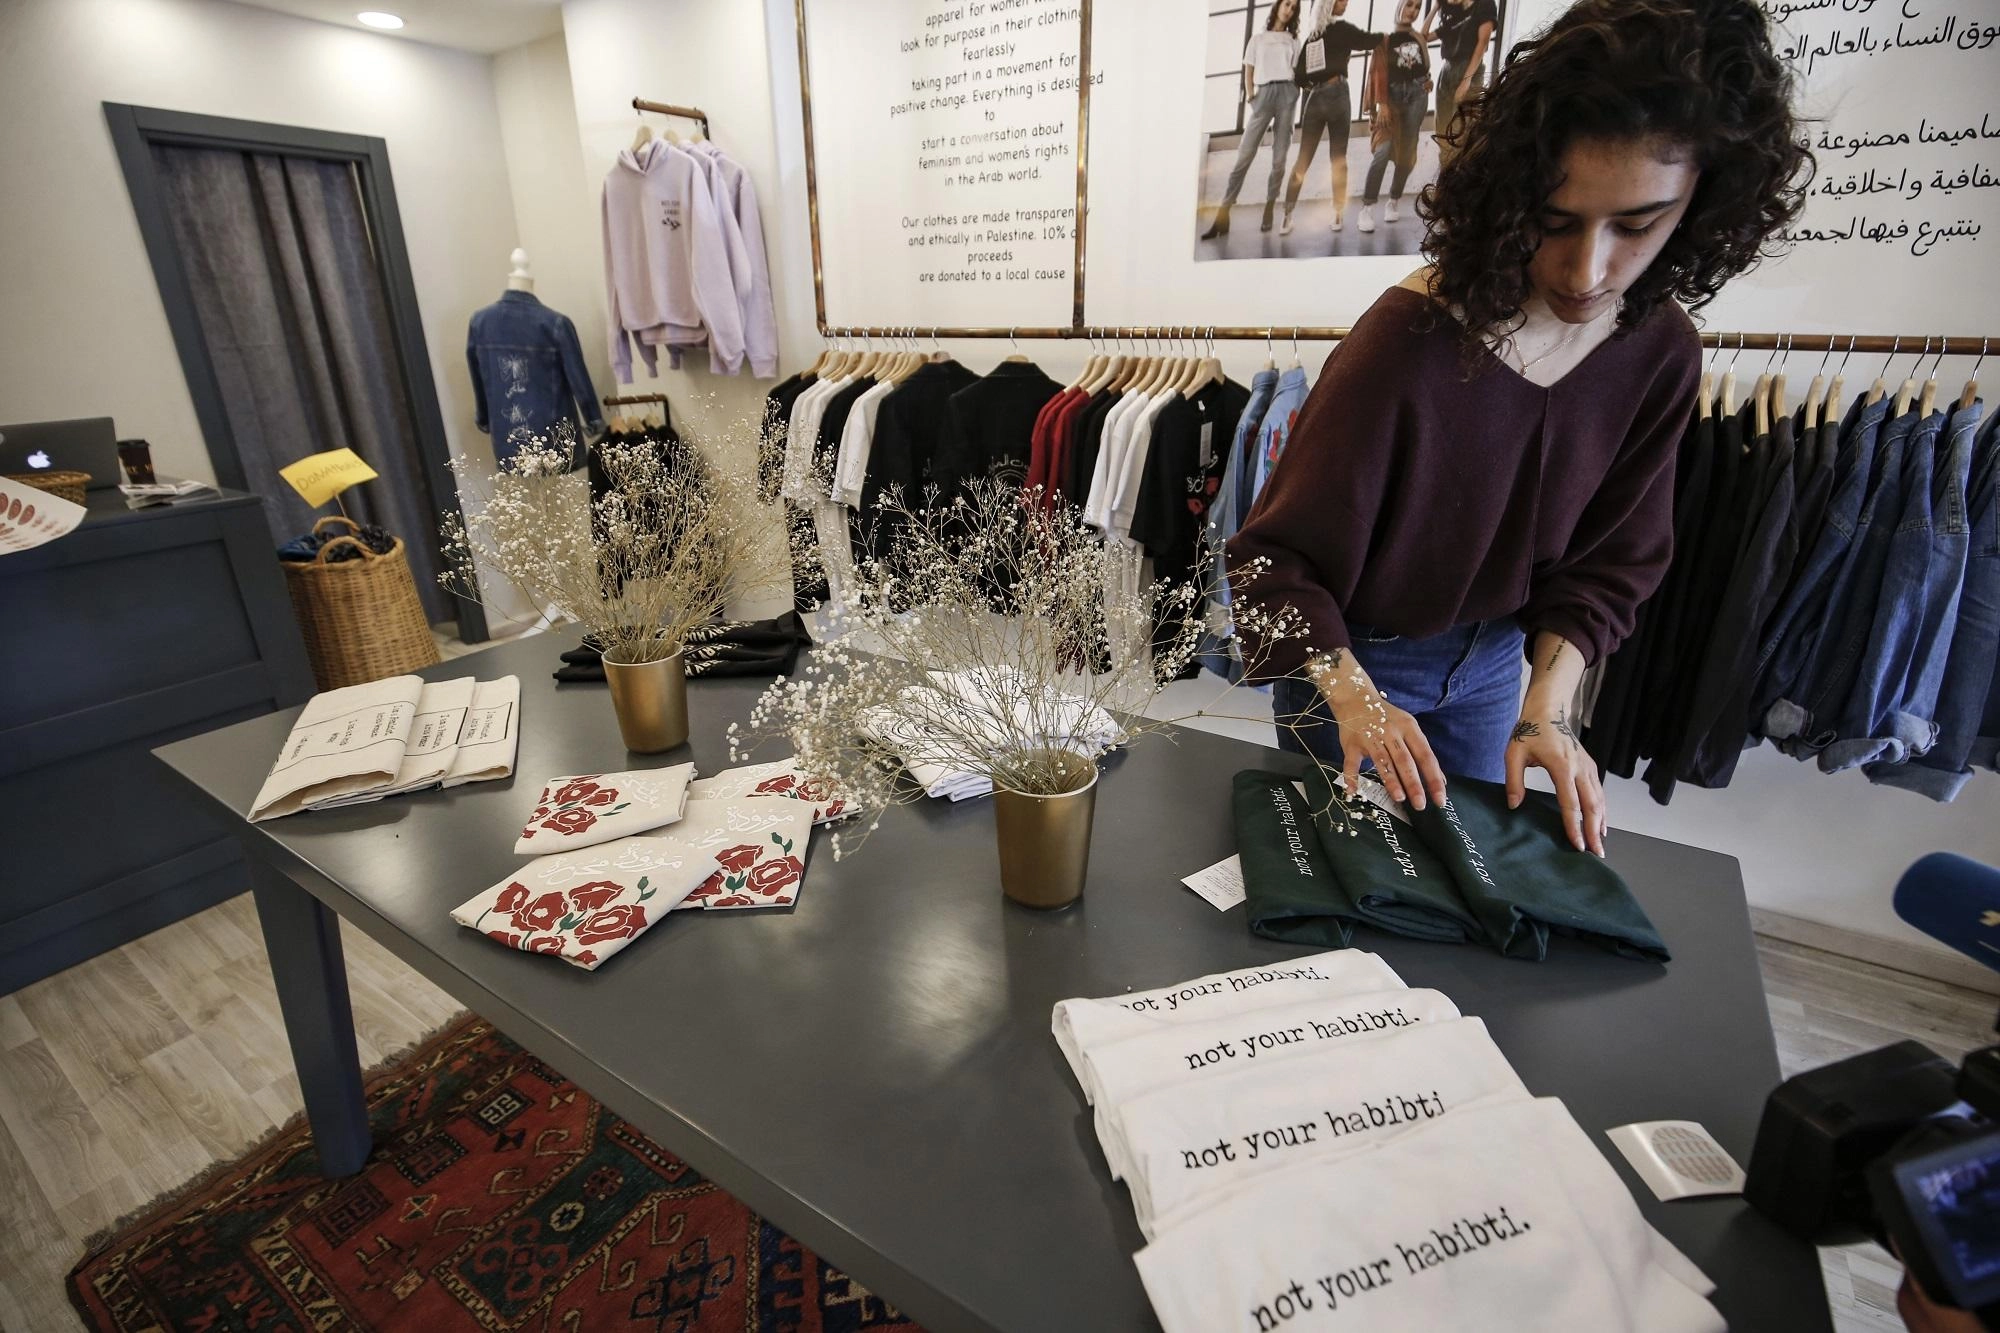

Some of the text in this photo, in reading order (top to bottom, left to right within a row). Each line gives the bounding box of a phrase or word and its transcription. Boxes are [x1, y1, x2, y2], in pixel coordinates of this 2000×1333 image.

[925, 8, 964, 28] apparel
[970, 3, 985, 18] for
[900, 37, 920, 53] look
[925, 33, 940, 48] for
[944, 26, 985, 48] purpose
[990, 22, 1000, 34] in
[1006, 16, 1033, 32] their
[1882, 15, 1957, 53] النساء
[963, 42, 1016, 61] fearlessly
[1808, 26, 1878, 76] بالعالم
[912, 53, 1077, 93] taking part in a movement for
[890, 70, 1104, 118] positive change. Everything is desiged
[985, 108, 996, 121] to
[922, 122, 1064, 150] start a conversation about
[1817, 131, 1910, 158] مصنوعة
[918, 156, 961, 169] feminism
[965, 151, 984, 164] and
[1035, 143, 1069, 162] rights
[945, 165, 1042, 187] in the Arab world.
[901, 216, 919, 229] Our
[923, 213, 958, 228] clothes
[962, 214, 978, 225] are
[983, 209, 1011, 224] made
[908, 233, 925, 247] and
[929, 231, 970, 247] ethically
[974, 230, 983, 243] in
[987, 228, 1037, 243] Palestine.
[1042, 225, 1066, 241] 10%
[1910, 219, 1982, 258] بنتبرع
[967, 250, 1014, 265] proceeds
[919, 267, 1066, 283] are donated to a local cause
[1269, 786, 1314, 877] not your habibti.
[1392, 855, 1418, 877] not
[1469, 858, 1496, 887] not
[1120, 997, 1161, 1014] ot
[1164, 980, 1223, 1012] your
[1185, 1007, 1421, 1071] not your habibti.
[1180, 1090, 1447, 1171] not your habibti
[1250, 1206, 1532, 1333] not your habibti.
